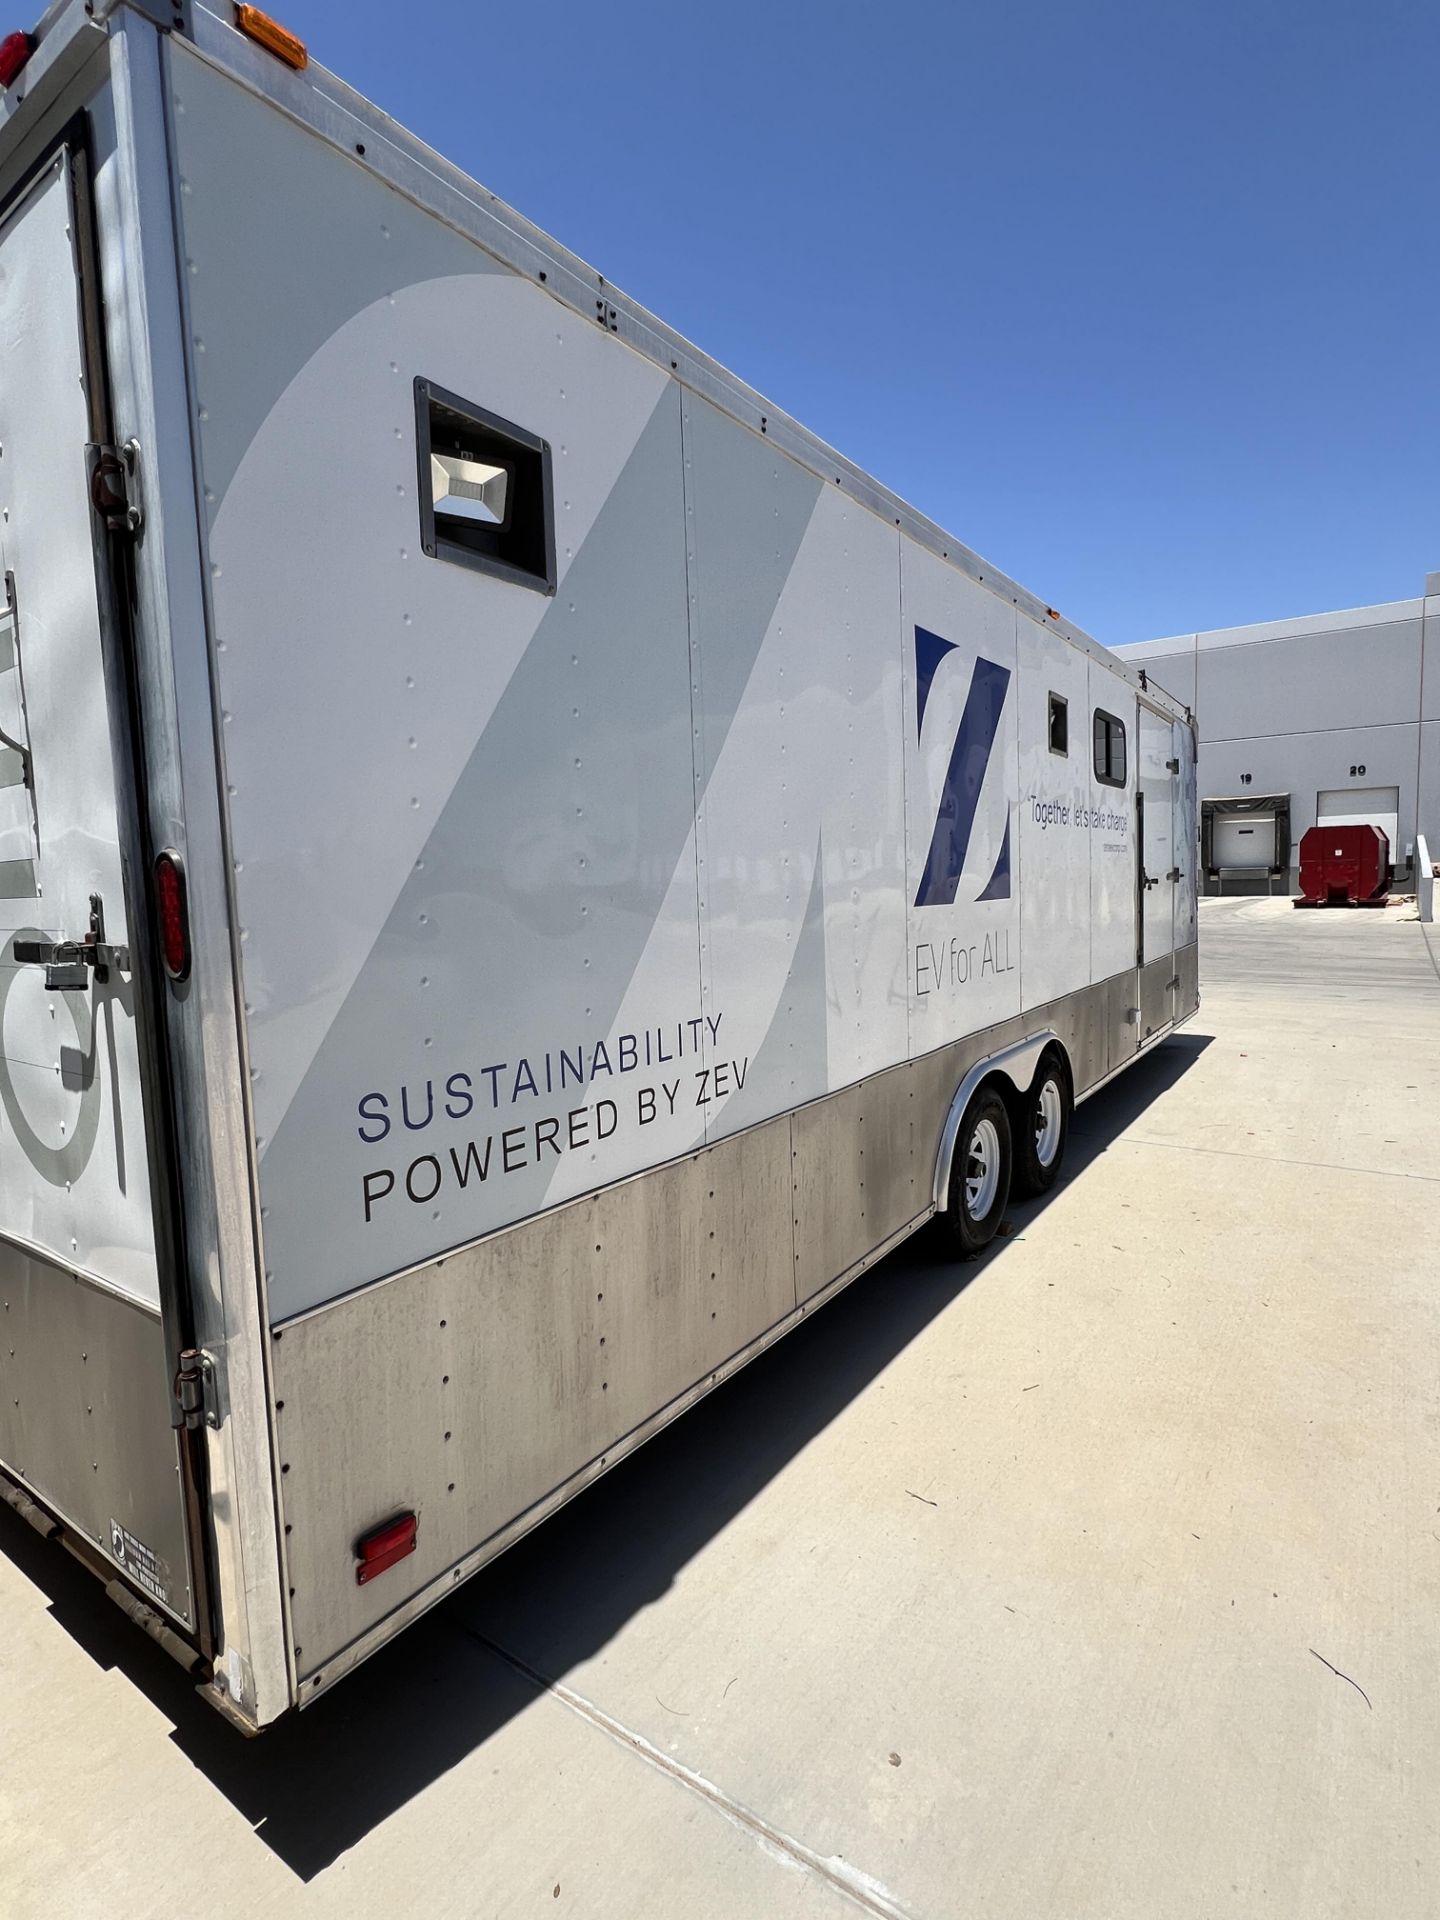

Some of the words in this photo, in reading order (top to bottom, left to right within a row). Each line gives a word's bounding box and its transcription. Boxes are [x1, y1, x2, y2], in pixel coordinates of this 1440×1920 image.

[1240, 773, 1252, 785] 19
[1350, 765, 1366, 777] 20
[1091, 807, 1106, 829] take
[916, 940, 945, 996] EV
[951, 937, 976, 985] for
[981, 929, 1015, 978] ALL
[357, 1012, 723, 1143] SUSTAINABILITY
[362, 1099, 618, 1222] POWERED
[638, 1079, 681, 1126] BY
[695, 1056, 749, 1106] ZEV
